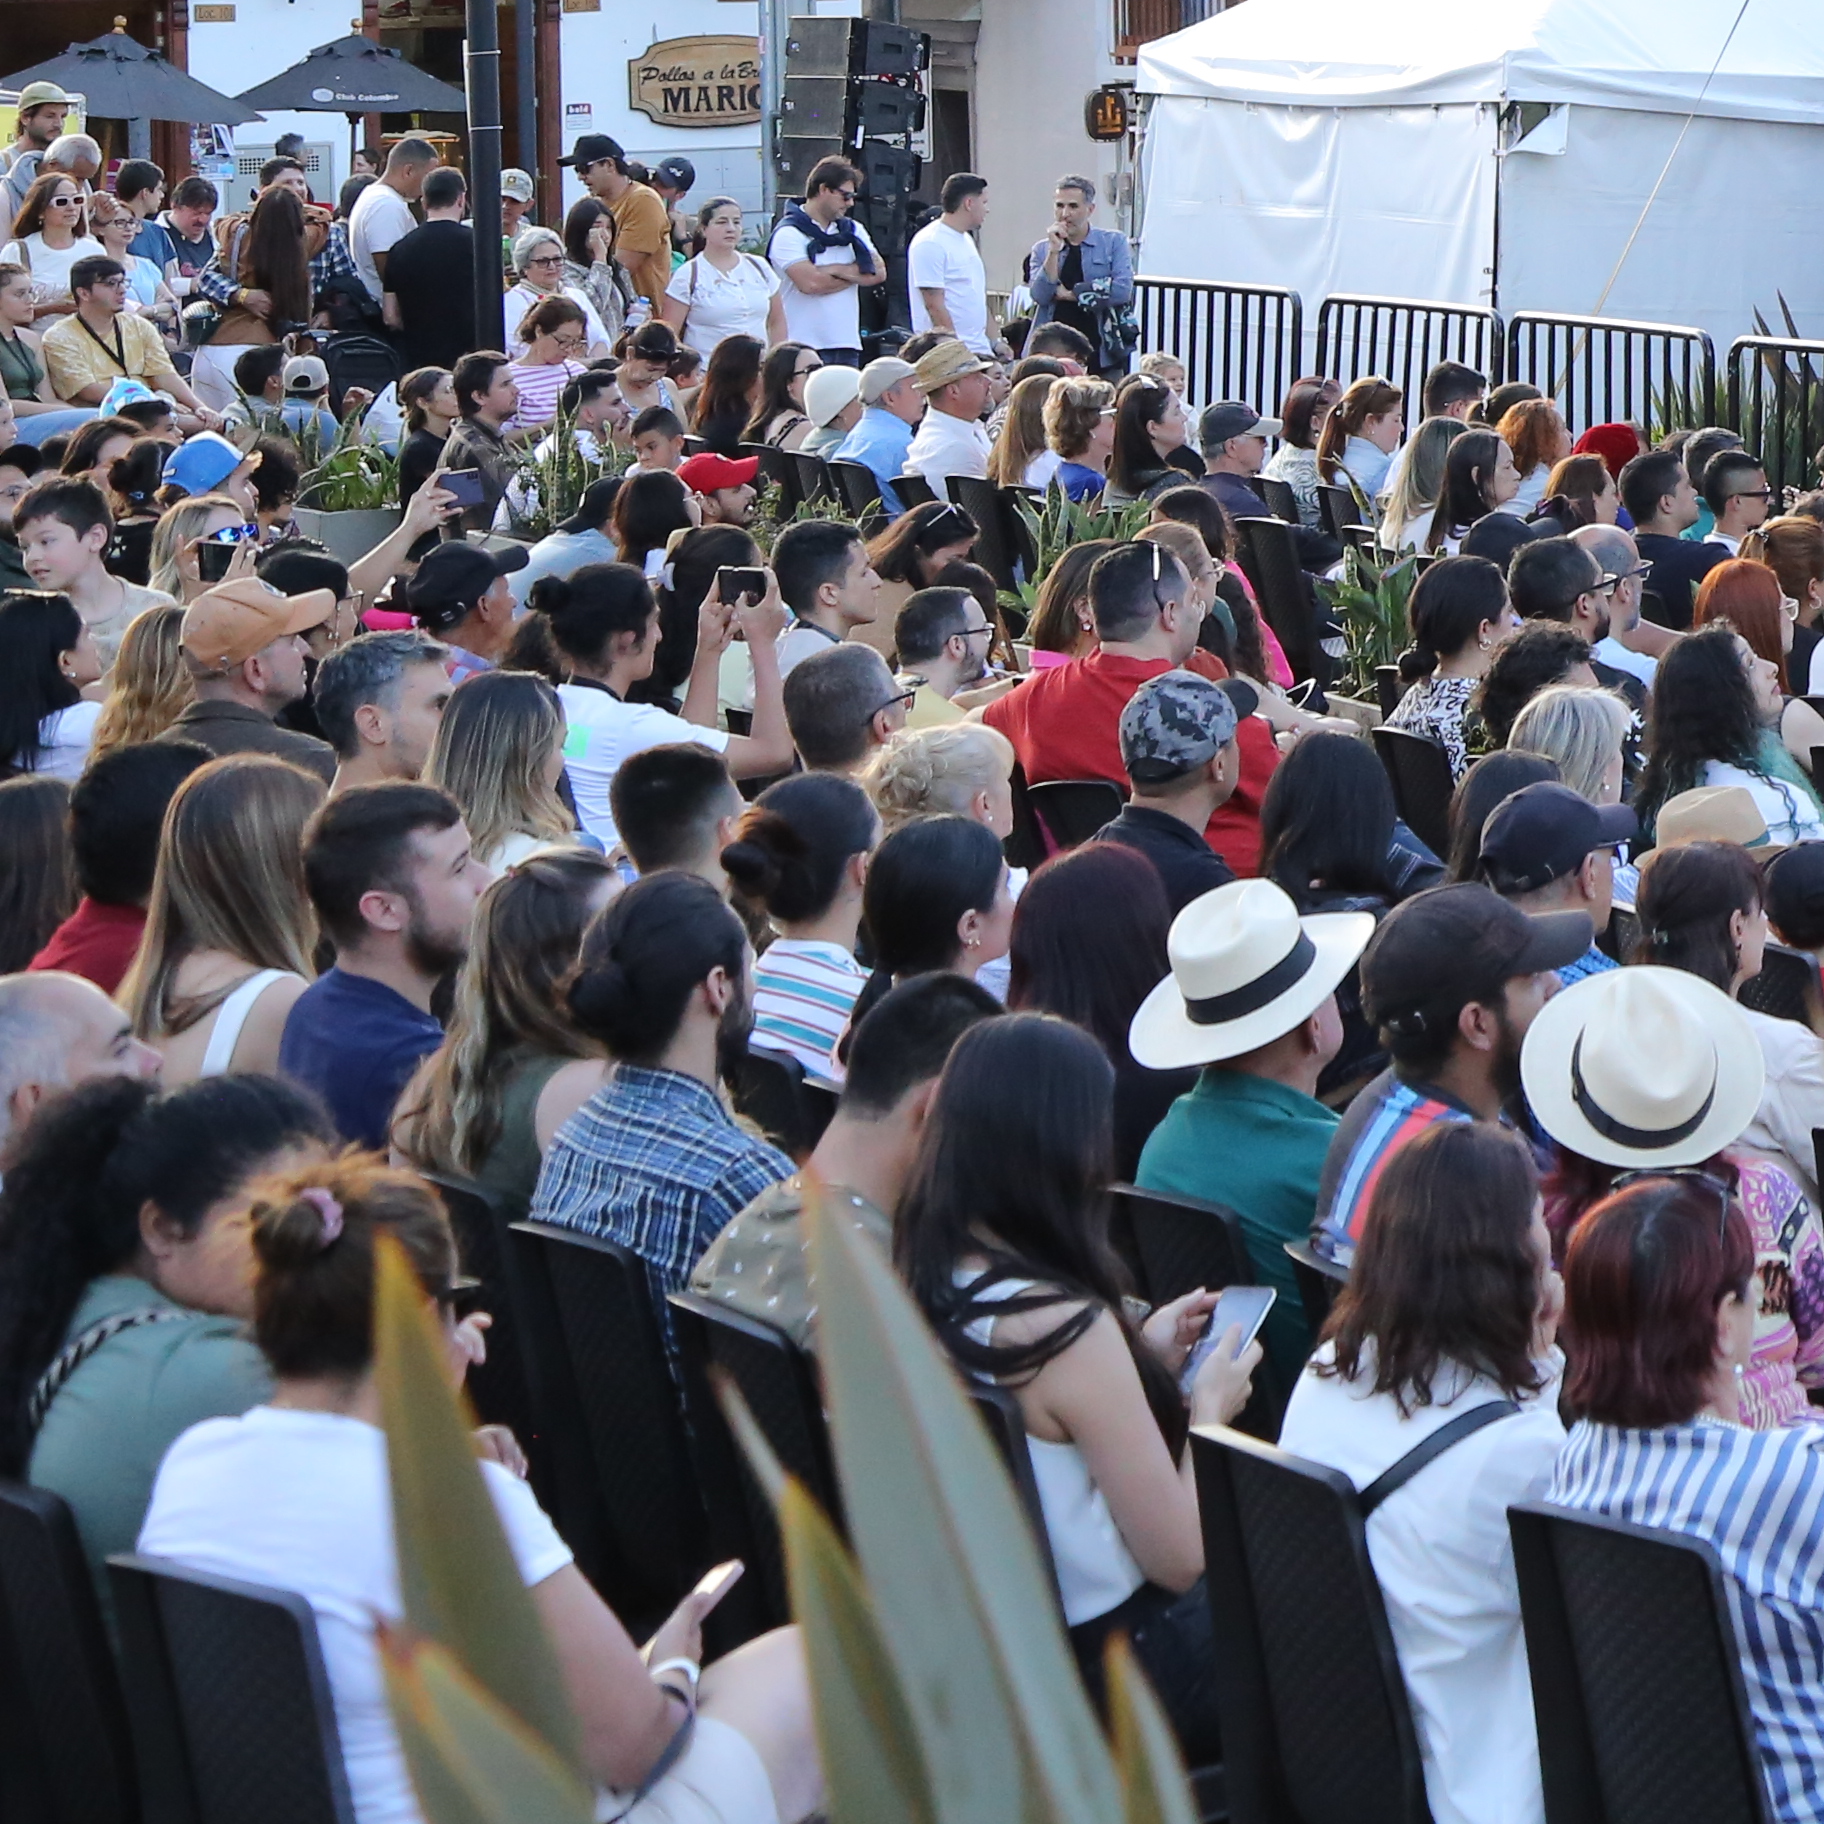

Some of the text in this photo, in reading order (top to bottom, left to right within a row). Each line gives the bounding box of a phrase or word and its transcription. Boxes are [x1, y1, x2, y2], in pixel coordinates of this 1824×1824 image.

[641, 60, 760, 85] Pollos a la Br
